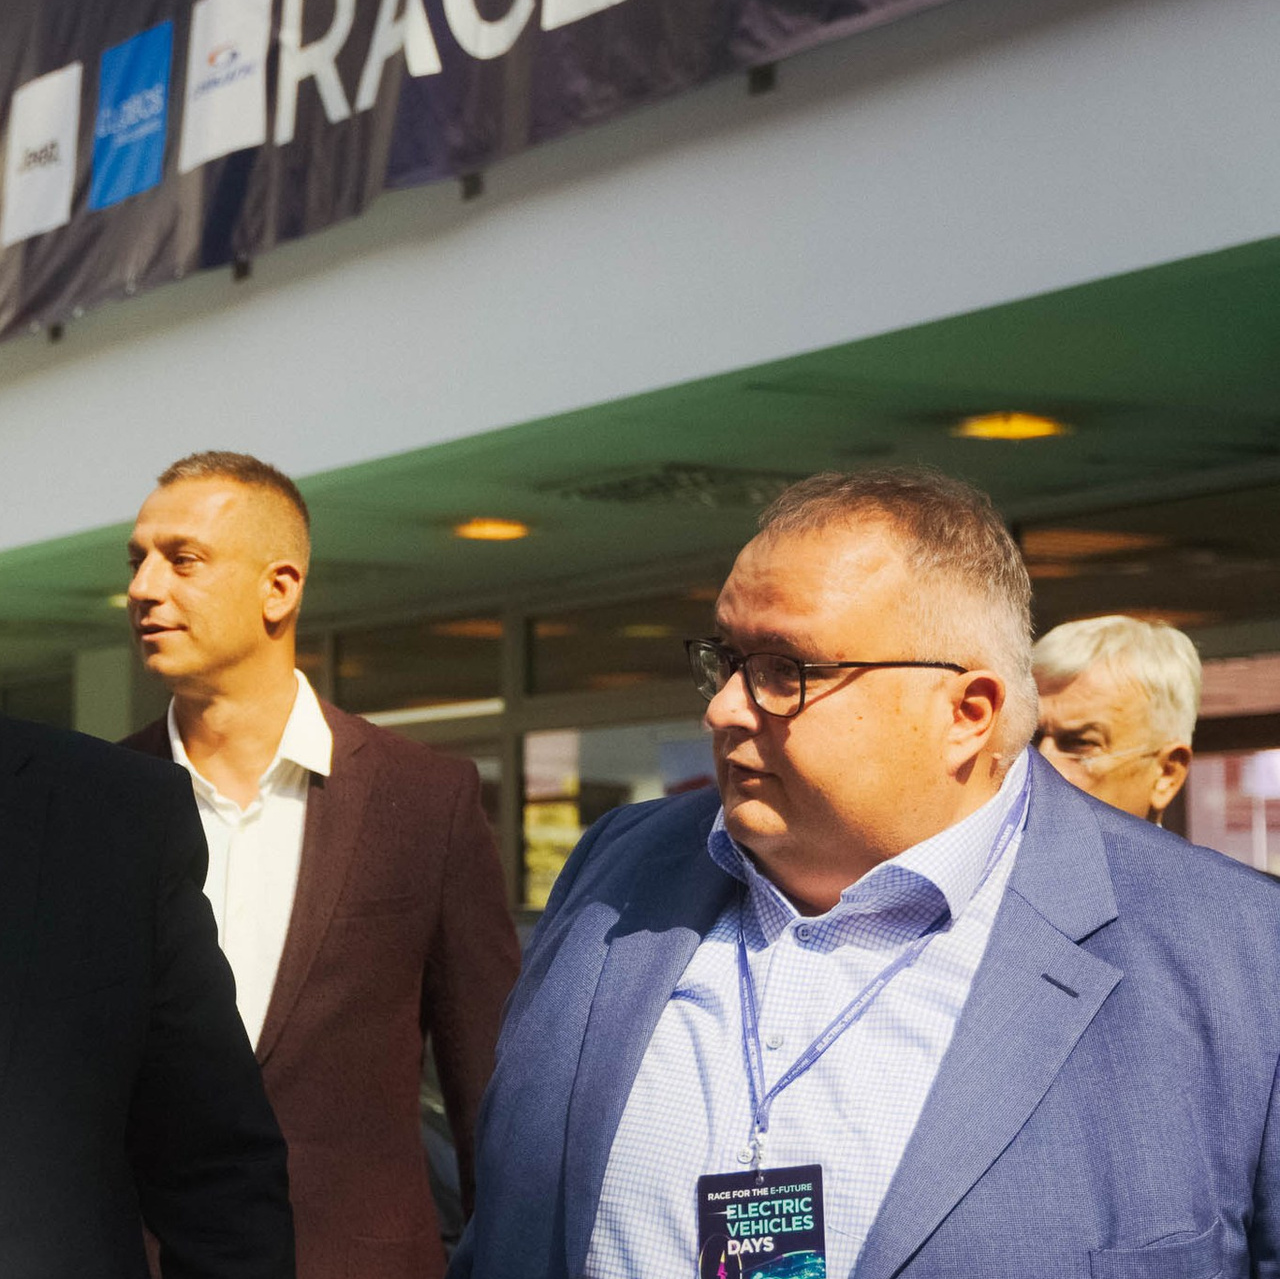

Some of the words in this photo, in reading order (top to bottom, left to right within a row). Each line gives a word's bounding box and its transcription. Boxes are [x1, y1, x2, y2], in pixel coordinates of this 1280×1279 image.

[707, 1192, 730, 1201] RACE
[732, 1190, 750, 1199] FOR
[752, 1188, 768, 1196] THE
[770, 1182, 812, 1194] E-FUTURE
[726, 1197, 812, 1220] ELECTRIC
[726, 1215, 814, 1237] VEHICLES
[727, 1236, 774, 1255] DAYS
